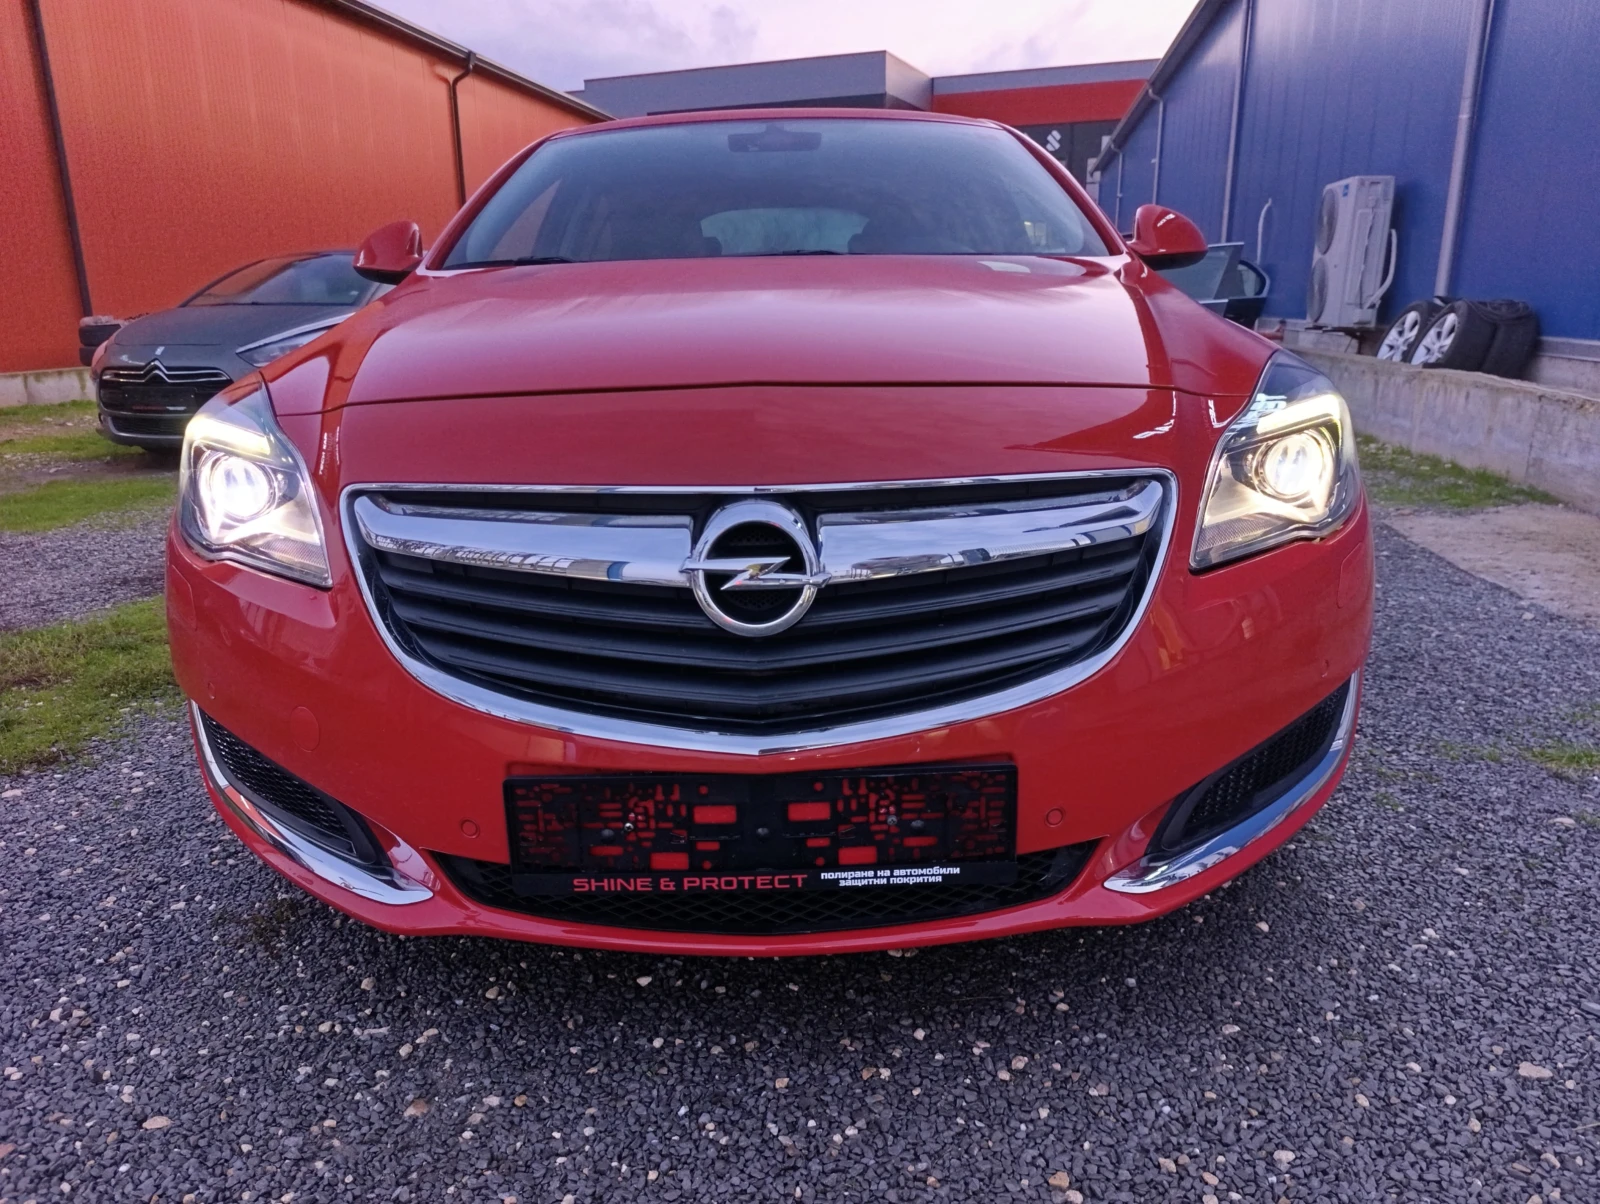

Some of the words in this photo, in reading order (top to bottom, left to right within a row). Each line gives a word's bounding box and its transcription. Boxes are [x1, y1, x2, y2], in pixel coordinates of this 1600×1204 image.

[820, 870, 875, 880] полиране
[877, 869, 891, 877] на
[893, 866, 960, 876] автомобили
[572, 877, 653, 892] SHINE
[659, 877, 676, 891] &
[683, 874, 808, 891] PROTECT
[838, 876, 887, 887] защитни
[889, 874, 943, 885] покрития
